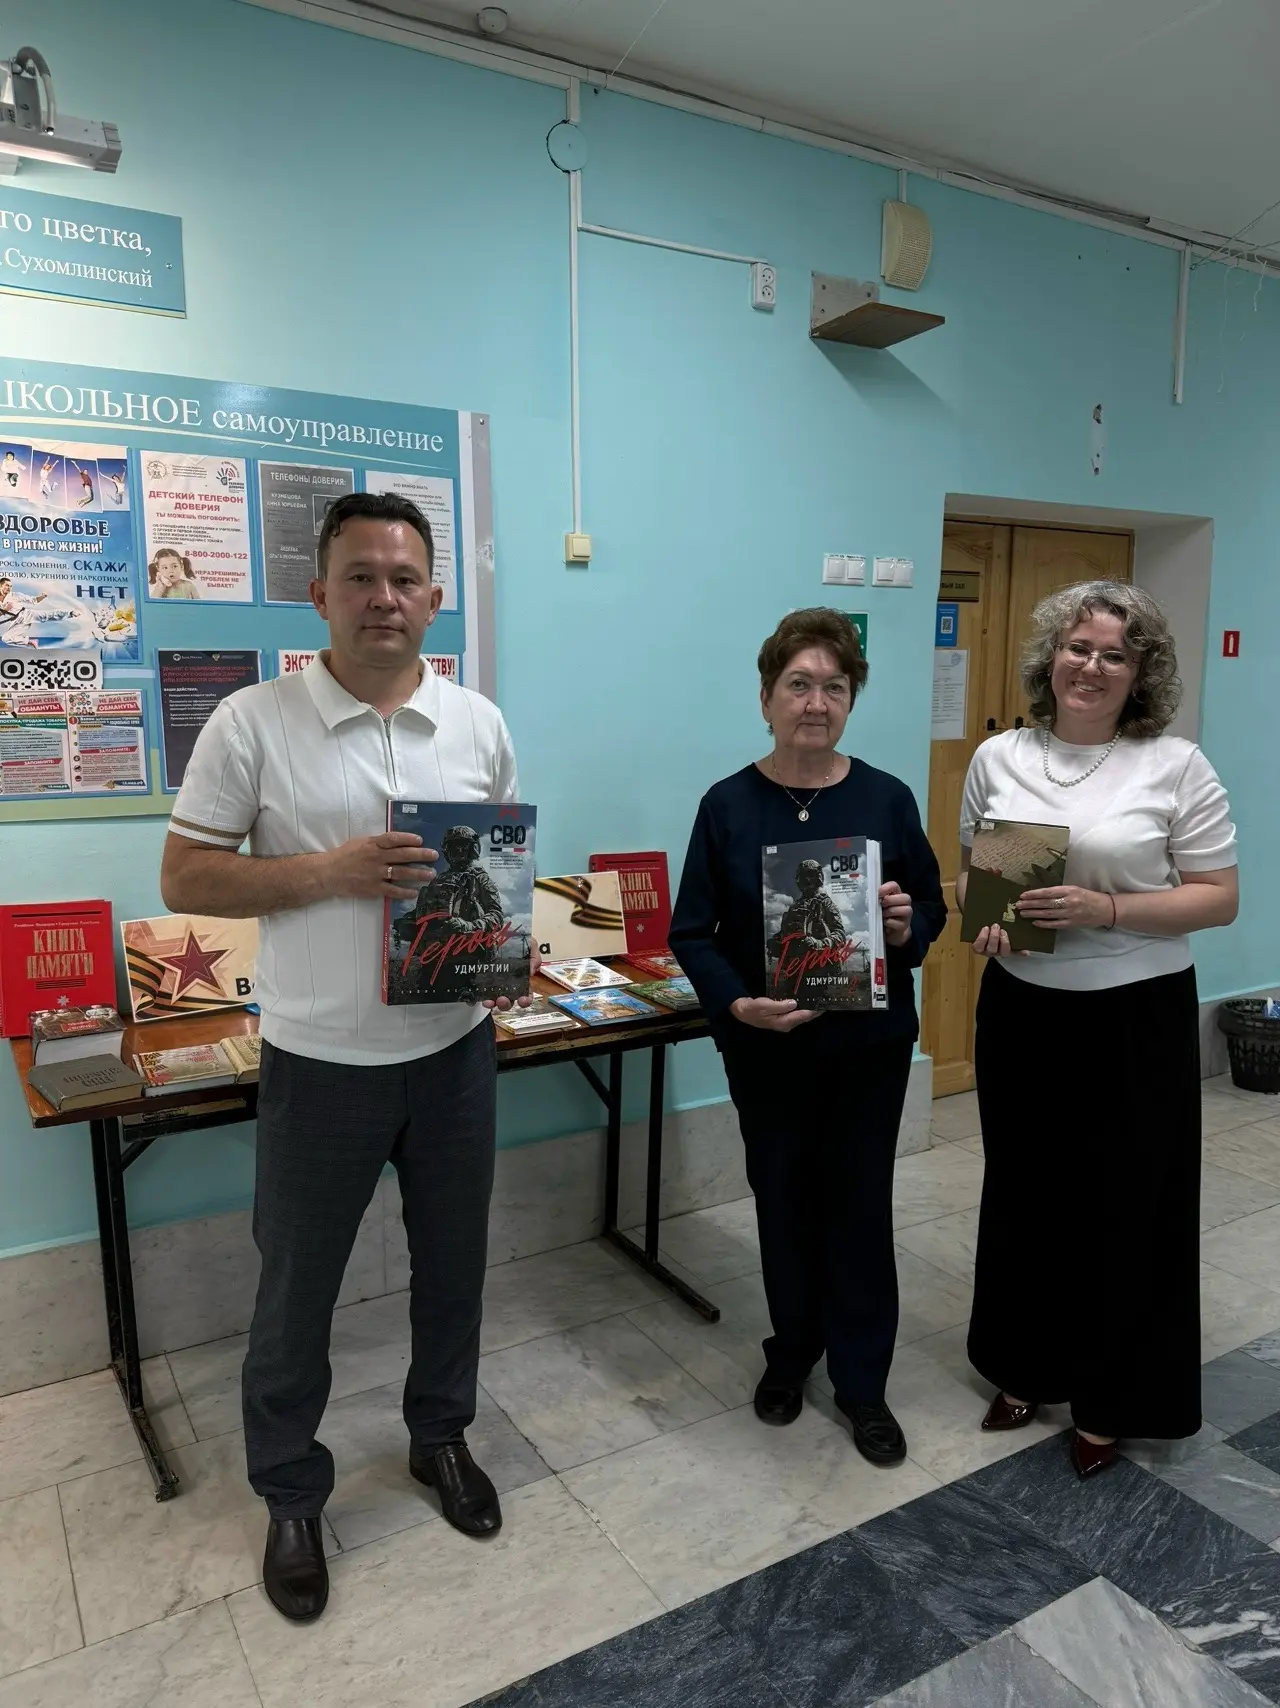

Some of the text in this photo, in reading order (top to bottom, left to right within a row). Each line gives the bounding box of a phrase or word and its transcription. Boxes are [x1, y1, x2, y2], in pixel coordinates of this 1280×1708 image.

[42, 217, 152, 257] цветка,
[212, 409, 444, 453] самоуправление
[270, 472, 346, 486] ТЕЛЕФОНЫ ДОВЕРИЯ:
[148, 490, 244, 504] ДЕТСКИЙ ТЕЛЕФОН
[174, 502, 220, 512] ДОВЕРИЯ
[3, 539, 103, 554] в ритме жизни!
[185, 550, 248, 560] 8-800-2000-122
[73, 560, 128, 572] СКАЖИ
[30, 572, 68, 580] КУРЕНИЮ
[78, 574, 128, 582] НАРКОТИКАМ
[76, 585, 128, 600] НЕТ
[284, 654, 315, 672] ЭКСТ
[426, 658, 455, 675] СТВУ!
[491, 825, 526, 844] СВО
[830, 854, 858, 872] СВО
[620, 872, 653, 891] КНИГА
[620, 891, 658, 911] АМЯТИ
[33, 928, 86, 953] КНИГА
[27, 952, 94, 979] ПАМЯТИ
[455, 964, 510, 974] УДМУРТИИ
[236, 978, 256, 996] В
[806, 977, 849, 986] УДМУРТИИ
